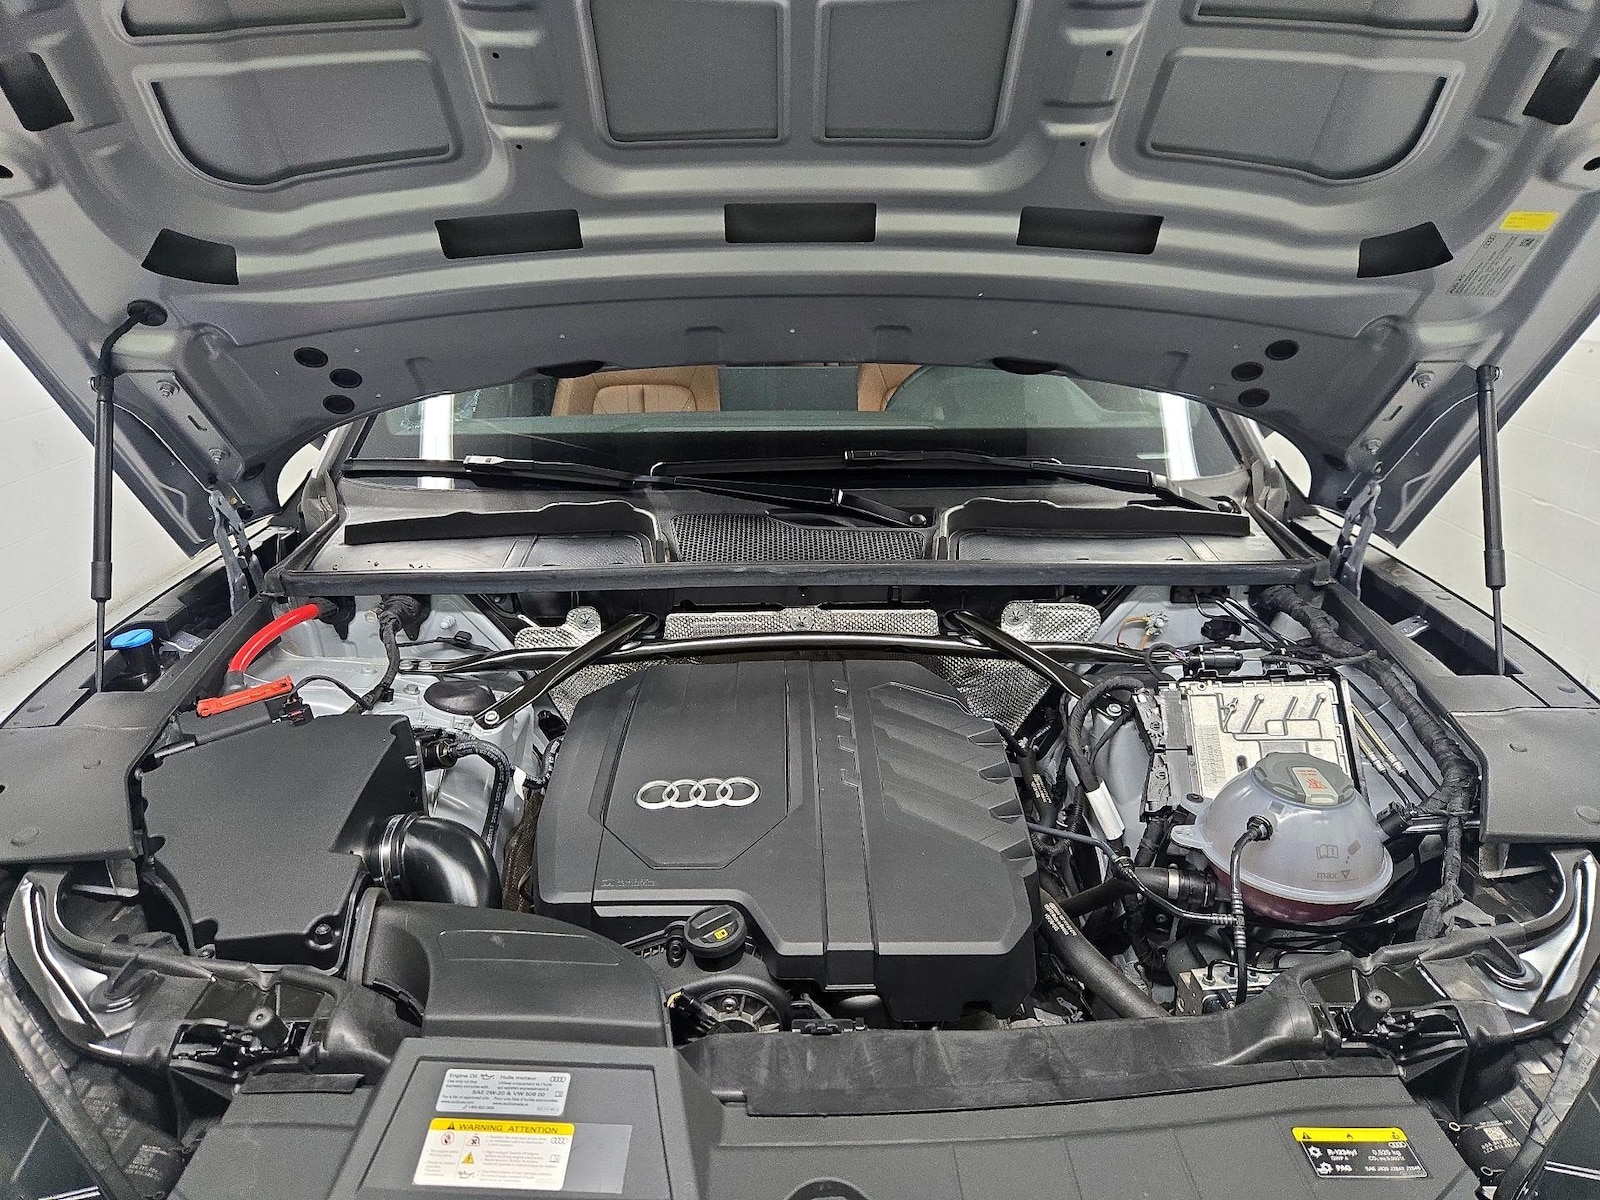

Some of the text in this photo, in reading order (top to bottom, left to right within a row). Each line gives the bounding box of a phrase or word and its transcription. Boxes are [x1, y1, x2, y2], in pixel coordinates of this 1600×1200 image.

[459, 1123, 559, 1134] WARNING ATTENTION
[1335, 1164, 1353, 1172] PAG
